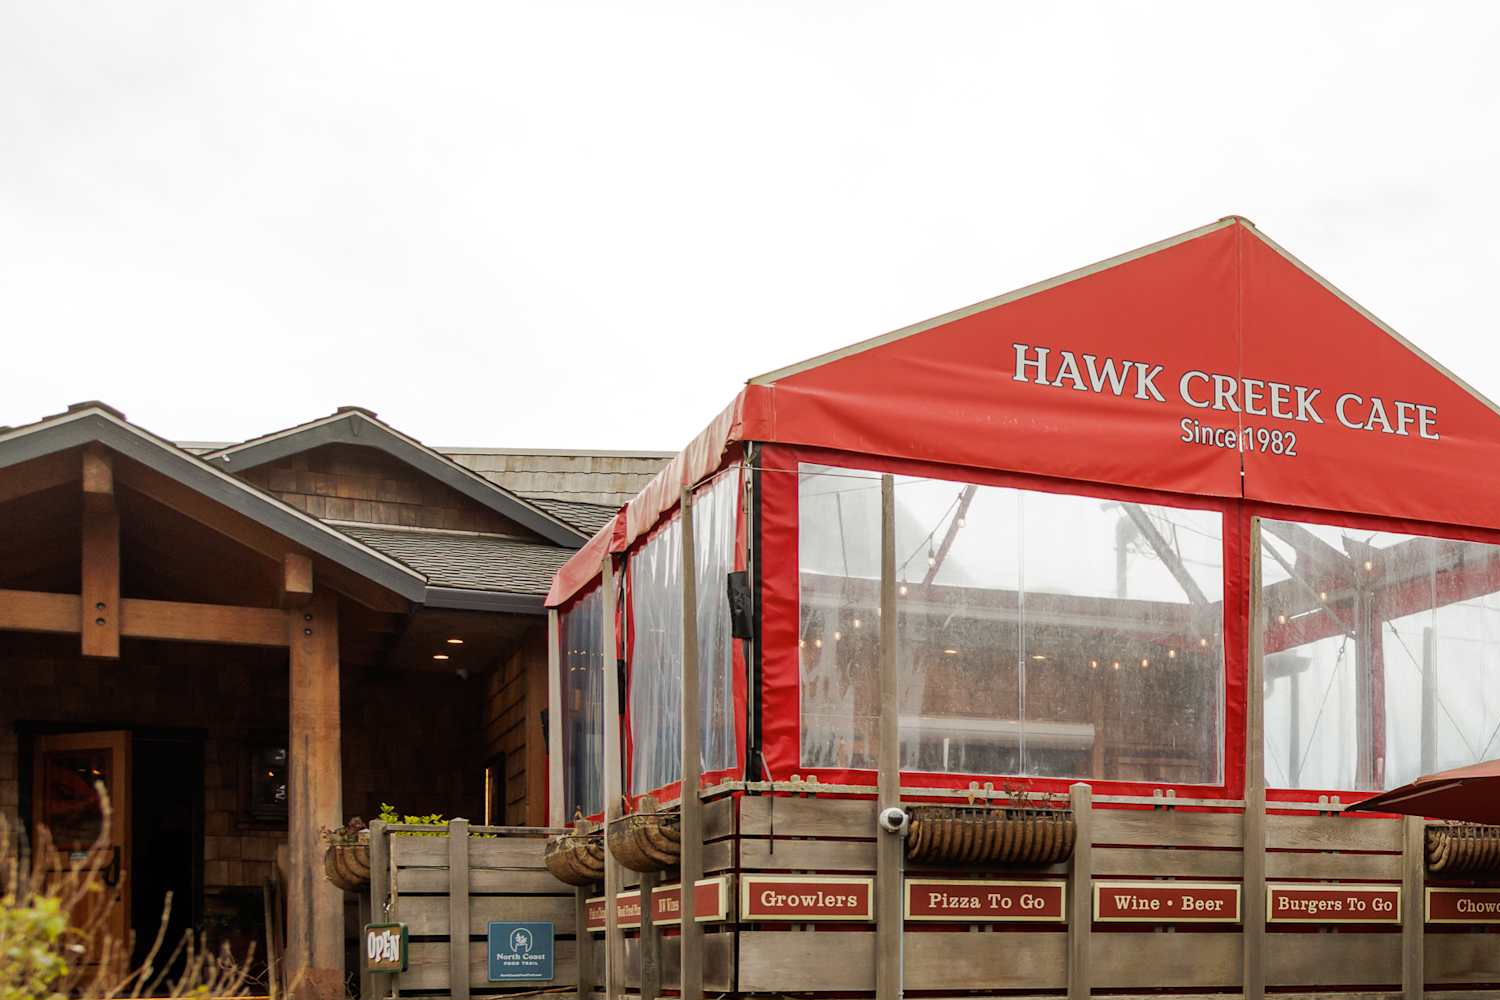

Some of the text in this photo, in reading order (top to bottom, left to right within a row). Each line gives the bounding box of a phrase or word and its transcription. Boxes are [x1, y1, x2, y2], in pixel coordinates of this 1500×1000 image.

[1012, 343, 1440, 441] HAWK CREEK CAFE
[1180, 417, 1298, 457] Since 1982
[760, 890, 858, 907] Growlers
[928, 892, 1045, 909] Pizza To Go
[1114, 895, 1223, 911] Wine Beer
[1278, 896, 1393, 914] Burgers To Go
[367, 930, 401, 962] OPEN
